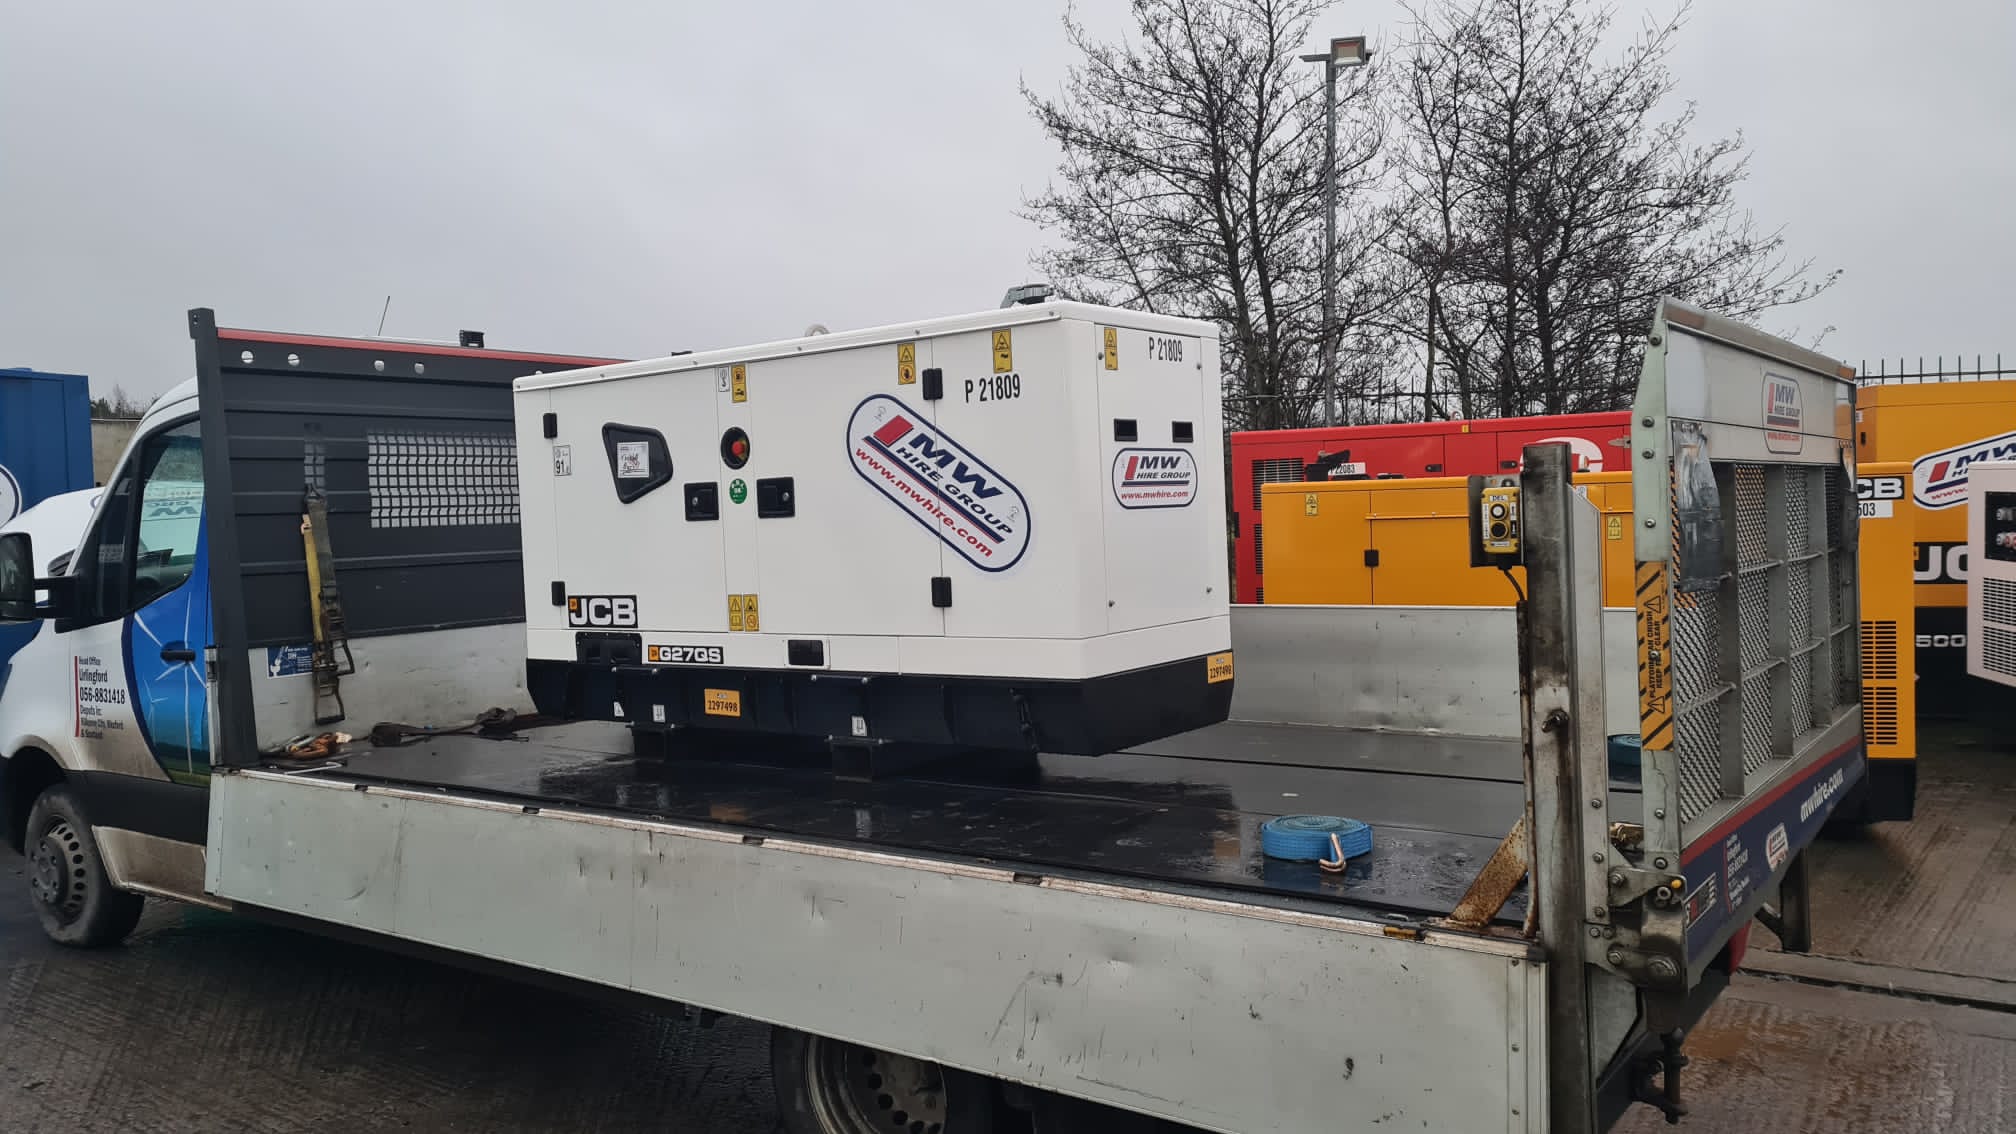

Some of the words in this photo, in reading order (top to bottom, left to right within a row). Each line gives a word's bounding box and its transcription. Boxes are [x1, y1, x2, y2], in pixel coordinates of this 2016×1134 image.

[1149, 337, 1155, 360] P
[1158, 337, 1183, 362] 21809
[964, 380, 973, 403] P
[979, 374, 1020, 402] 21809
[908, 432, 1004, 499] MW
[1139, 456, 1181, 469] MW
[1160, 471, 1191, 479] GROUP
[855, 448, 993, 557] www.mwhire.com
[896, 447, 943, 482] HIRE
[945, 483, 1013, 534] GROUP
[1121, 490, 1189, 500] www.mwhire.com
[569, 597, 636, 626] JCB
[659, 646, 722, 663] G27QS
[80, 687, 125, 704] 056-8831418
